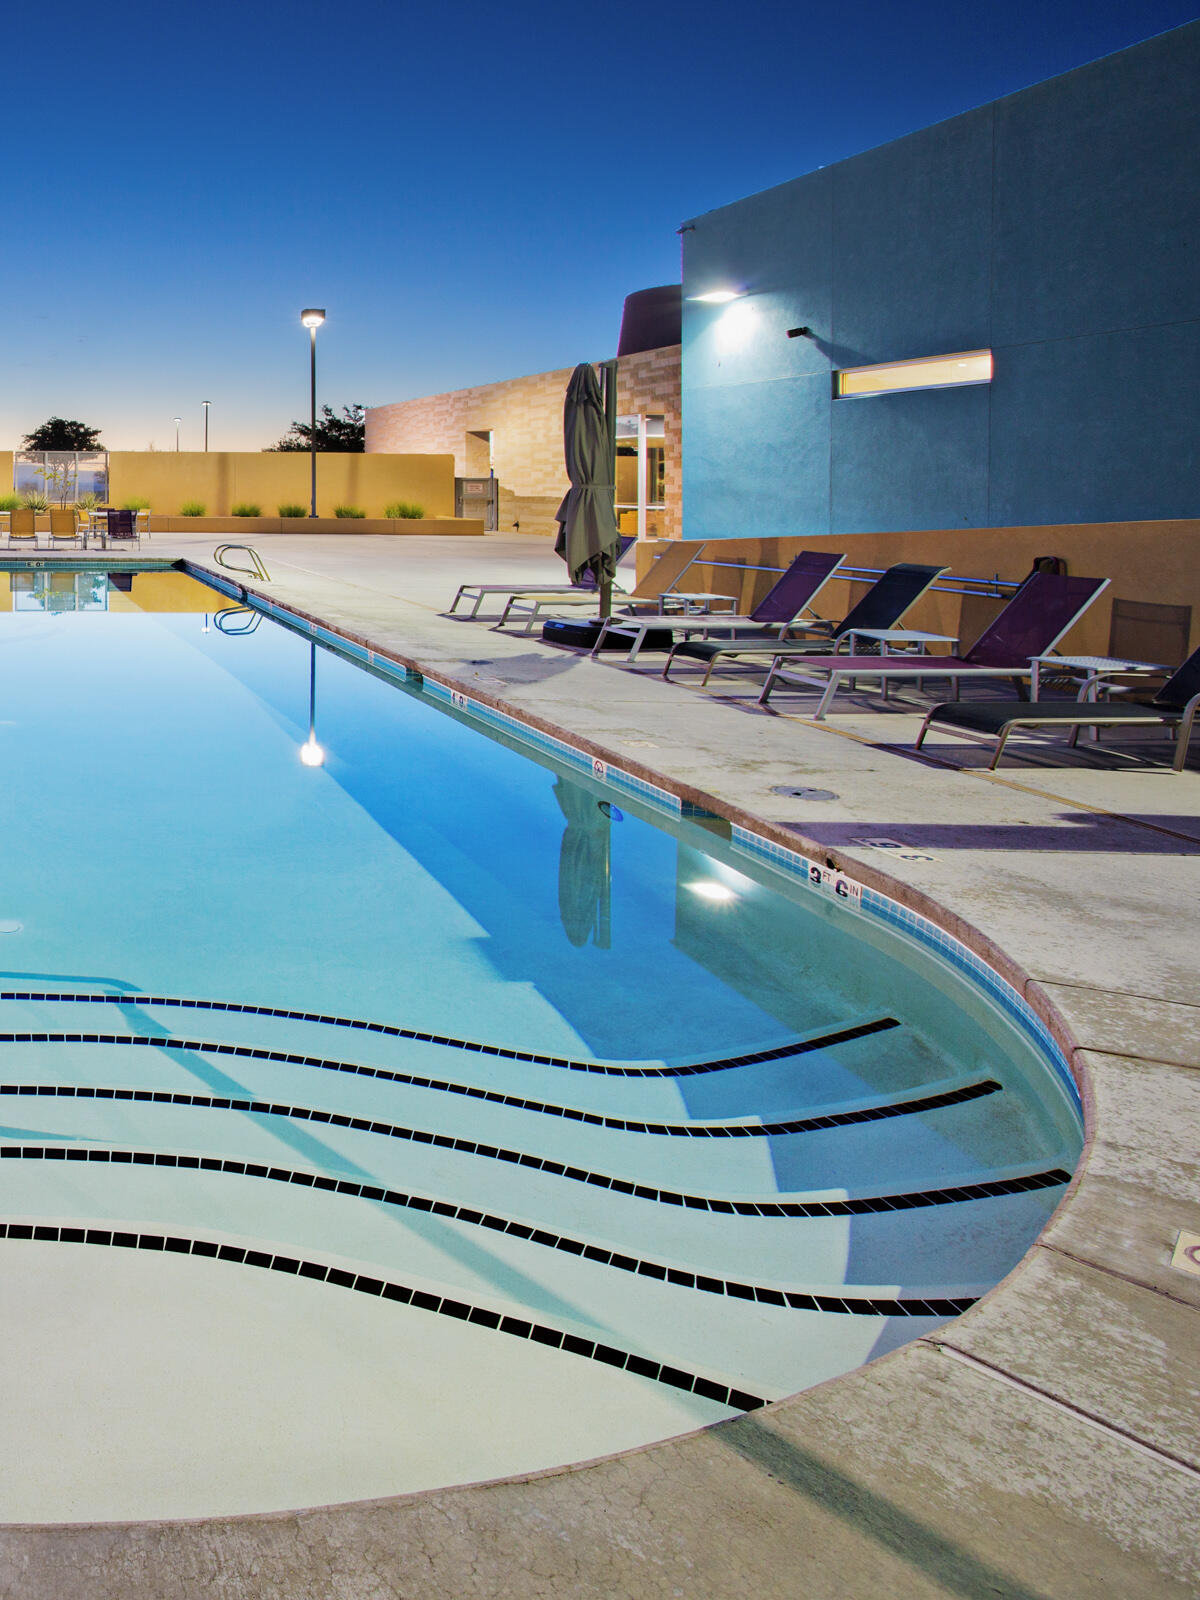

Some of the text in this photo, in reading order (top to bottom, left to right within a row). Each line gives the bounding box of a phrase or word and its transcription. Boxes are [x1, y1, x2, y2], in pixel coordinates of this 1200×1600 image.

[809, 867, 822, 884] 3
[822, 871, 831, 882] FT
[850, 885, 858, 897] IN
